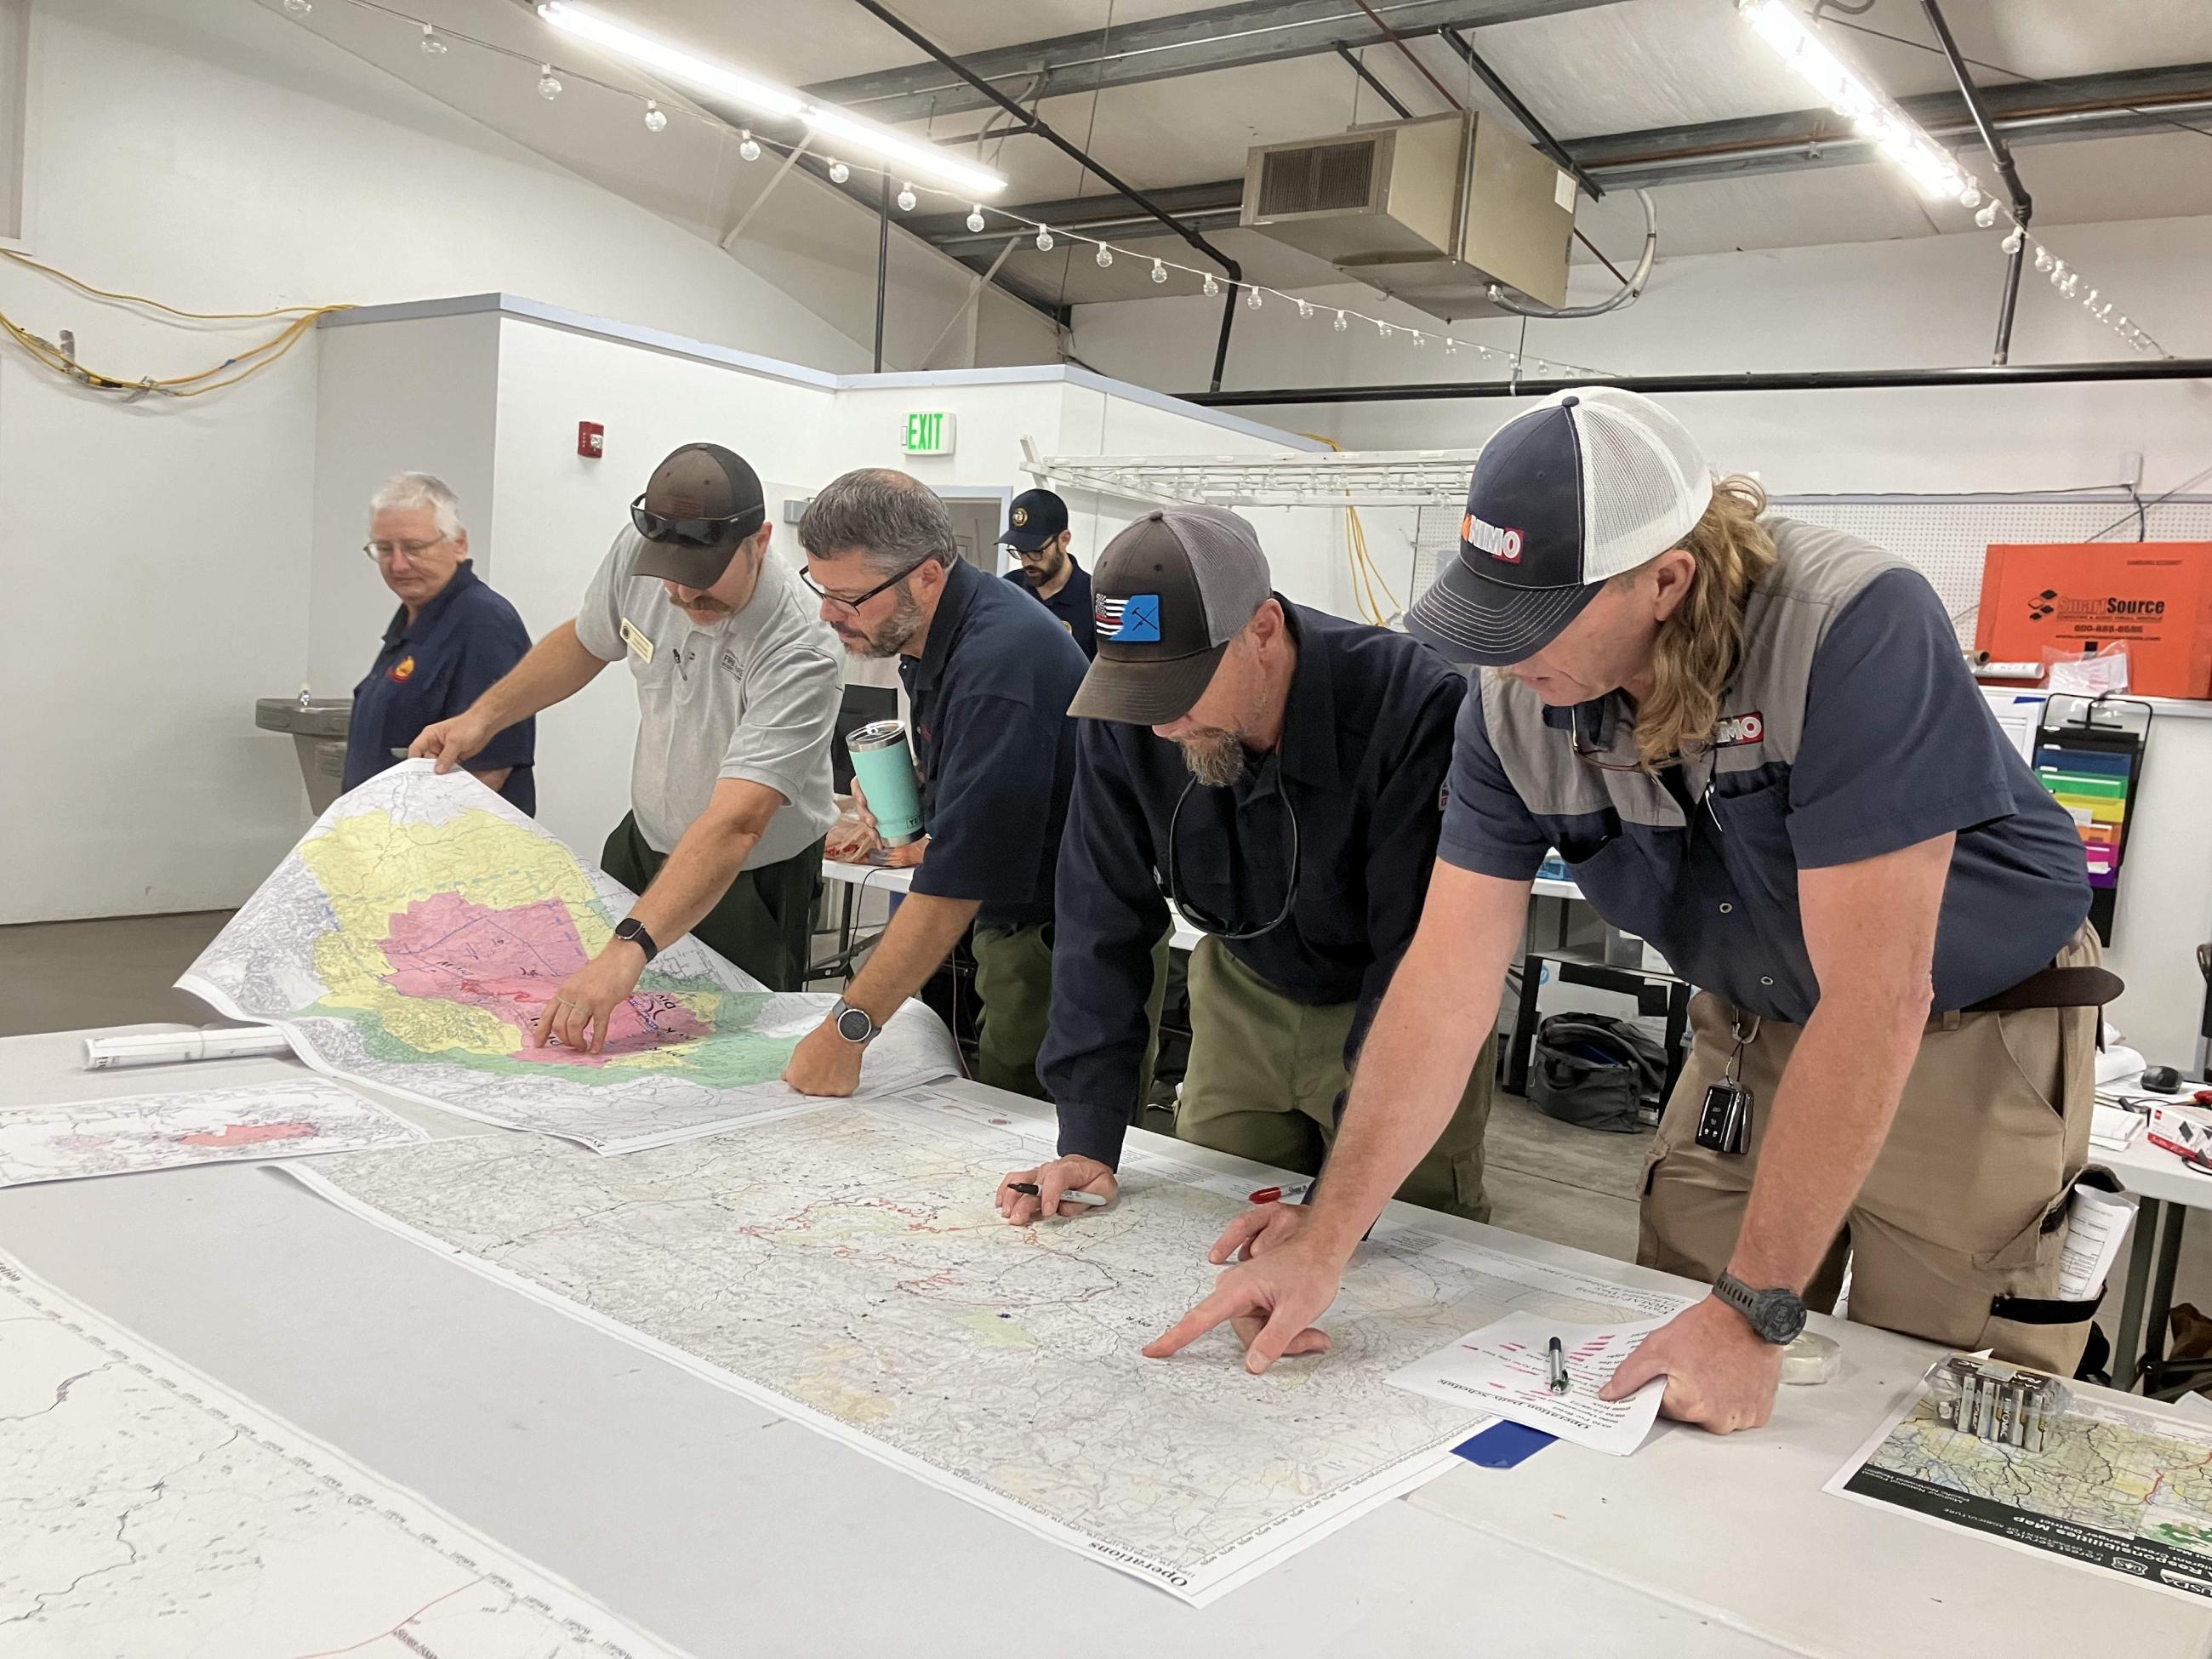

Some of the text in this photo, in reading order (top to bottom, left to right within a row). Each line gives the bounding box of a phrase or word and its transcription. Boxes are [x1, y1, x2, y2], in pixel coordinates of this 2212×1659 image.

[908, 413, 943, 449] EXIT
[1468, 514, 1520, 558] NIMO
[1437, 1378, 1487, 1398] Schedule
[1493, 1394, 1525, 1406] Daily
[1526, 1403, 1592, 1429] Operation
[1943, 1508, 2004, 1529] AGRICULTURE
[2039, 1519, 2083, 1535] District
[2006, 1531, 2101, 1562] Forest Service
[2013, 1516, 2203, 1575] Responsibilities Map
[2085, 1532, 2129, 1548] Ranger
[2134, 1545, 2169, 1559] Creek
[2169, 1546, 2192, 1556] Map
[1089, 1542, 1188, 1587] Operations
